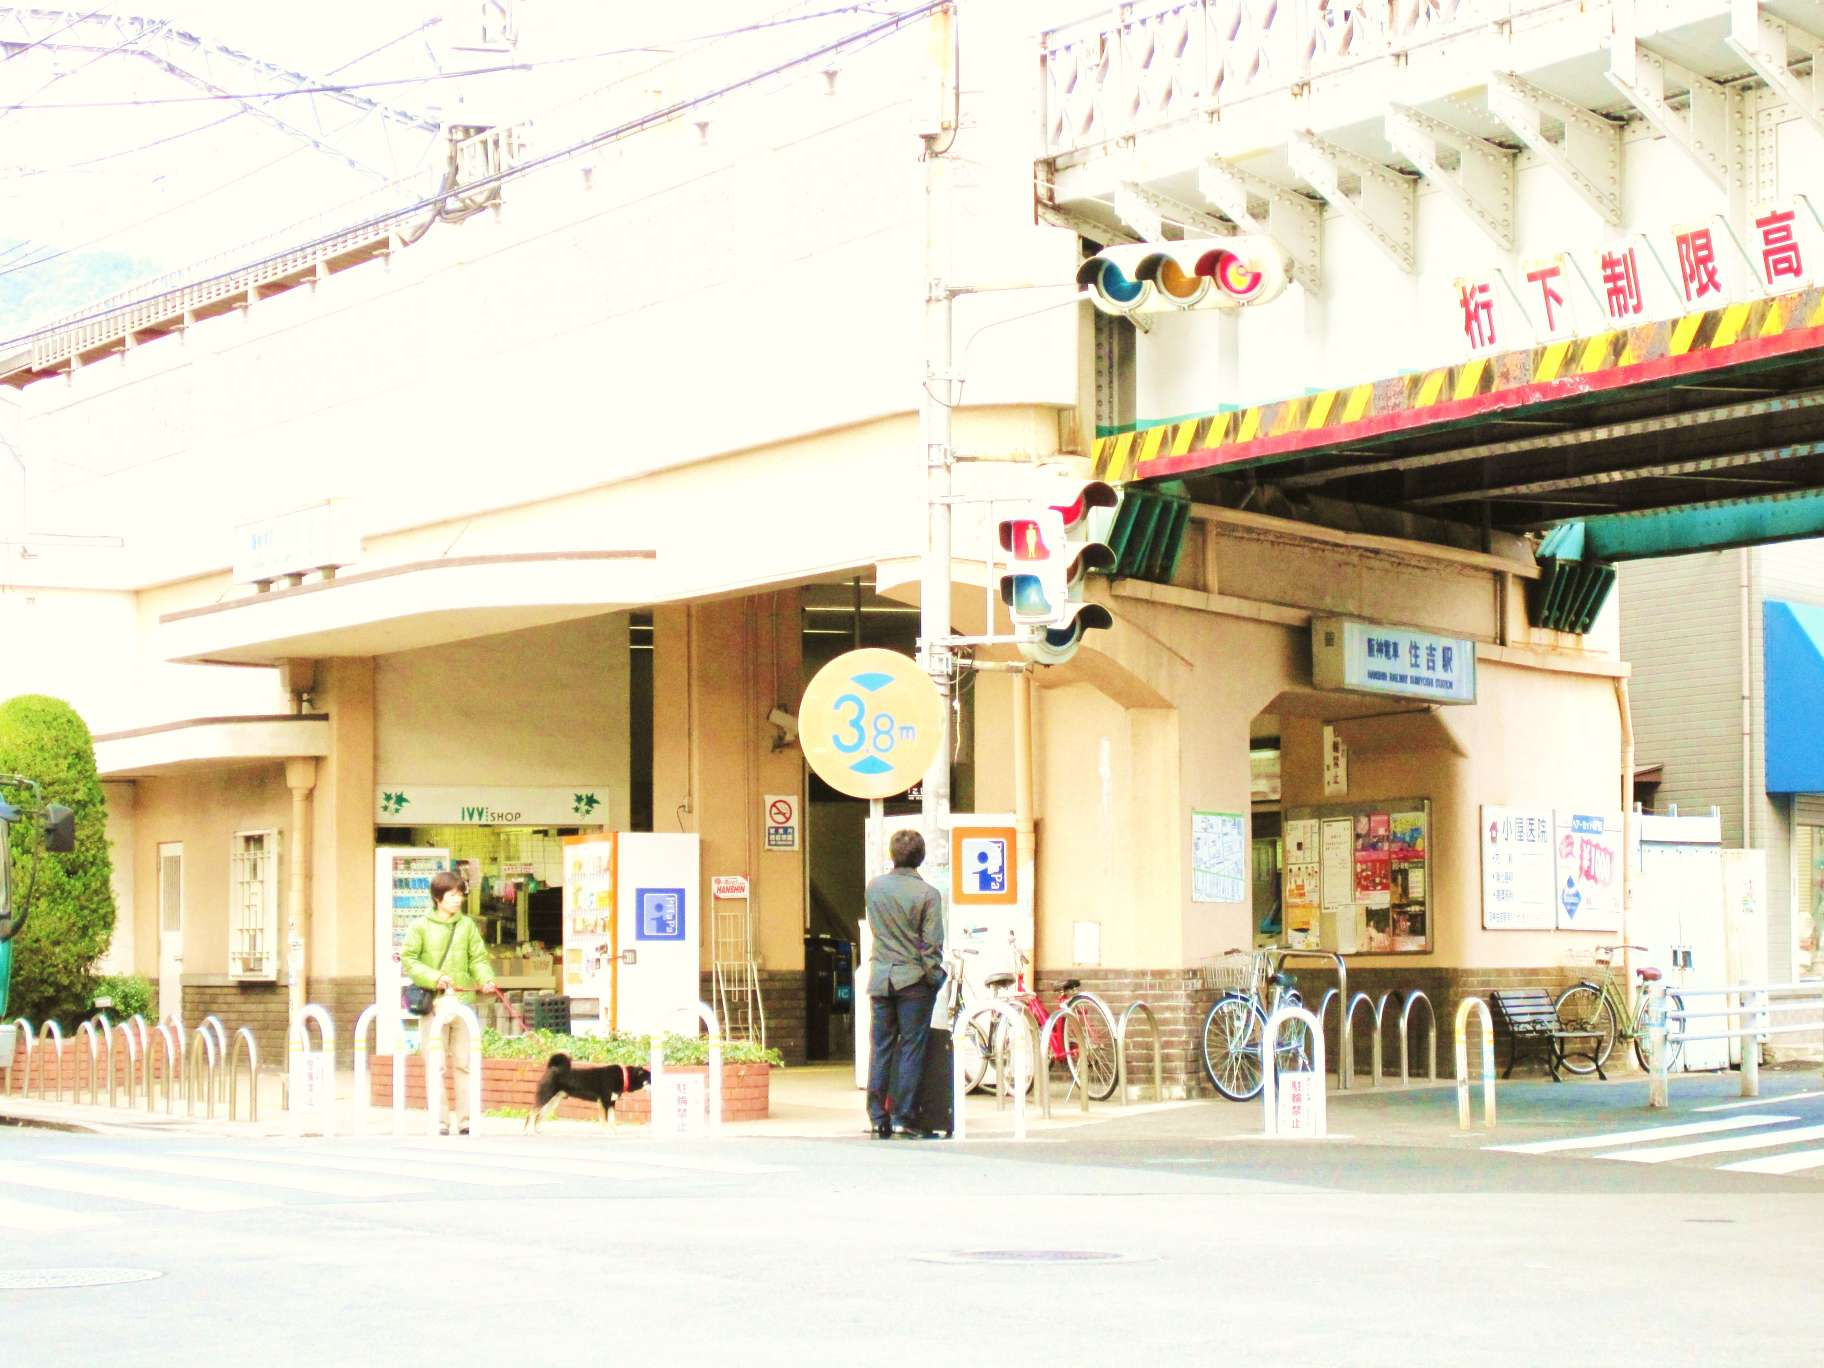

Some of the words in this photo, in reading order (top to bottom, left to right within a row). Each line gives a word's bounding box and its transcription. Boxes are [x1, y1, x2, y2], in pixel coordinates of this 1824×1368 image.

[1459, 210, 1803, 349] 桁下制限高
[1409, 640, 1453, 672] 住吉駅
[461, 807, 484, 821] IVY
[490, 812, 521, 821] SHOP
